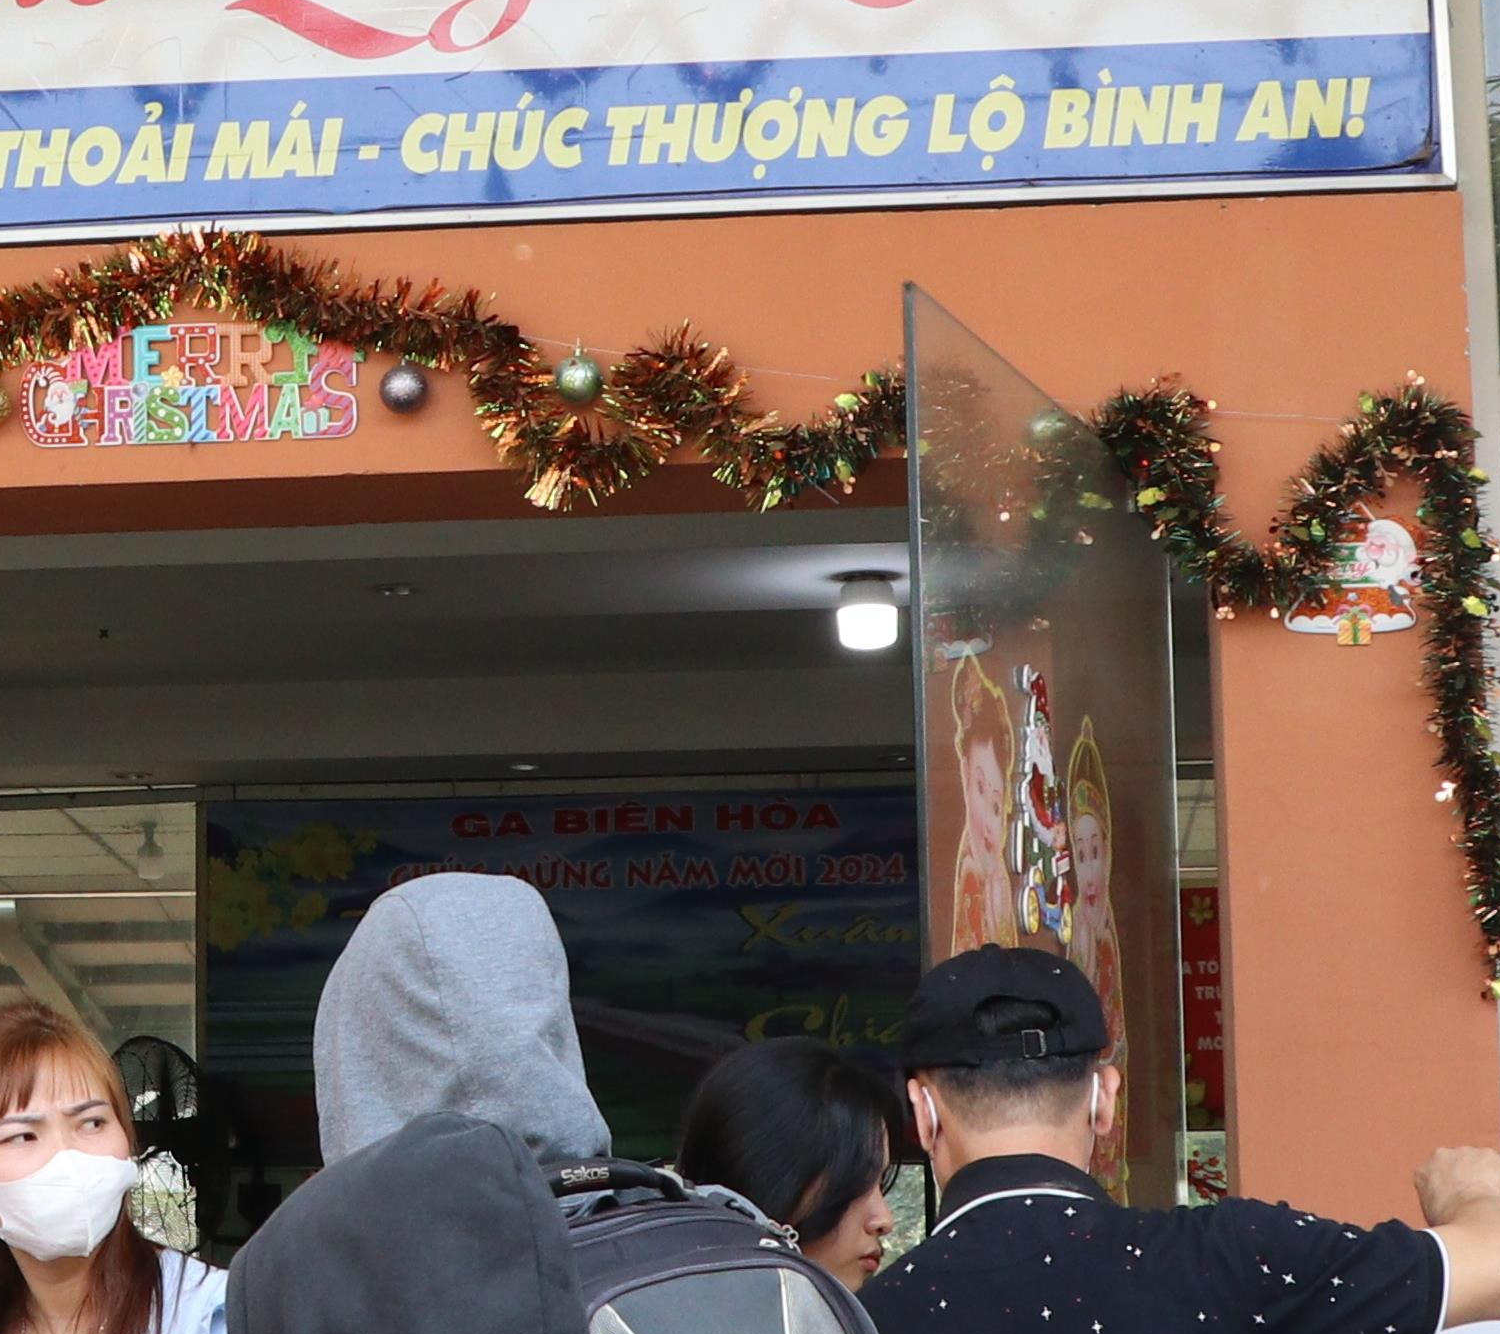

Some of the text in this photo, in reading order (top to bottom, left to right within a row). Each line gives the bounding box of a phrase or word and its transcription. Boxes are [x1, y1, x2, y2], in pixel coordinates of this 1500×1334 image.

[203, 100, 343, 180] MÁI
[401, 97, 588, 173] CHÚC
[606, 87, 908, 178] THƯỢNG
[926, 75, 1026, 171] LỘ
[1043, 69, 1220, 154] BÌNH
[1235, 77, 1368, 142] AN!
[451, 797, 841, 839] GA BIÊN HÒA
[627, 856, 718, 887] NĂM
[726, 852, 803, 887] MỚI
[815, 853, 905, 885] 2024
